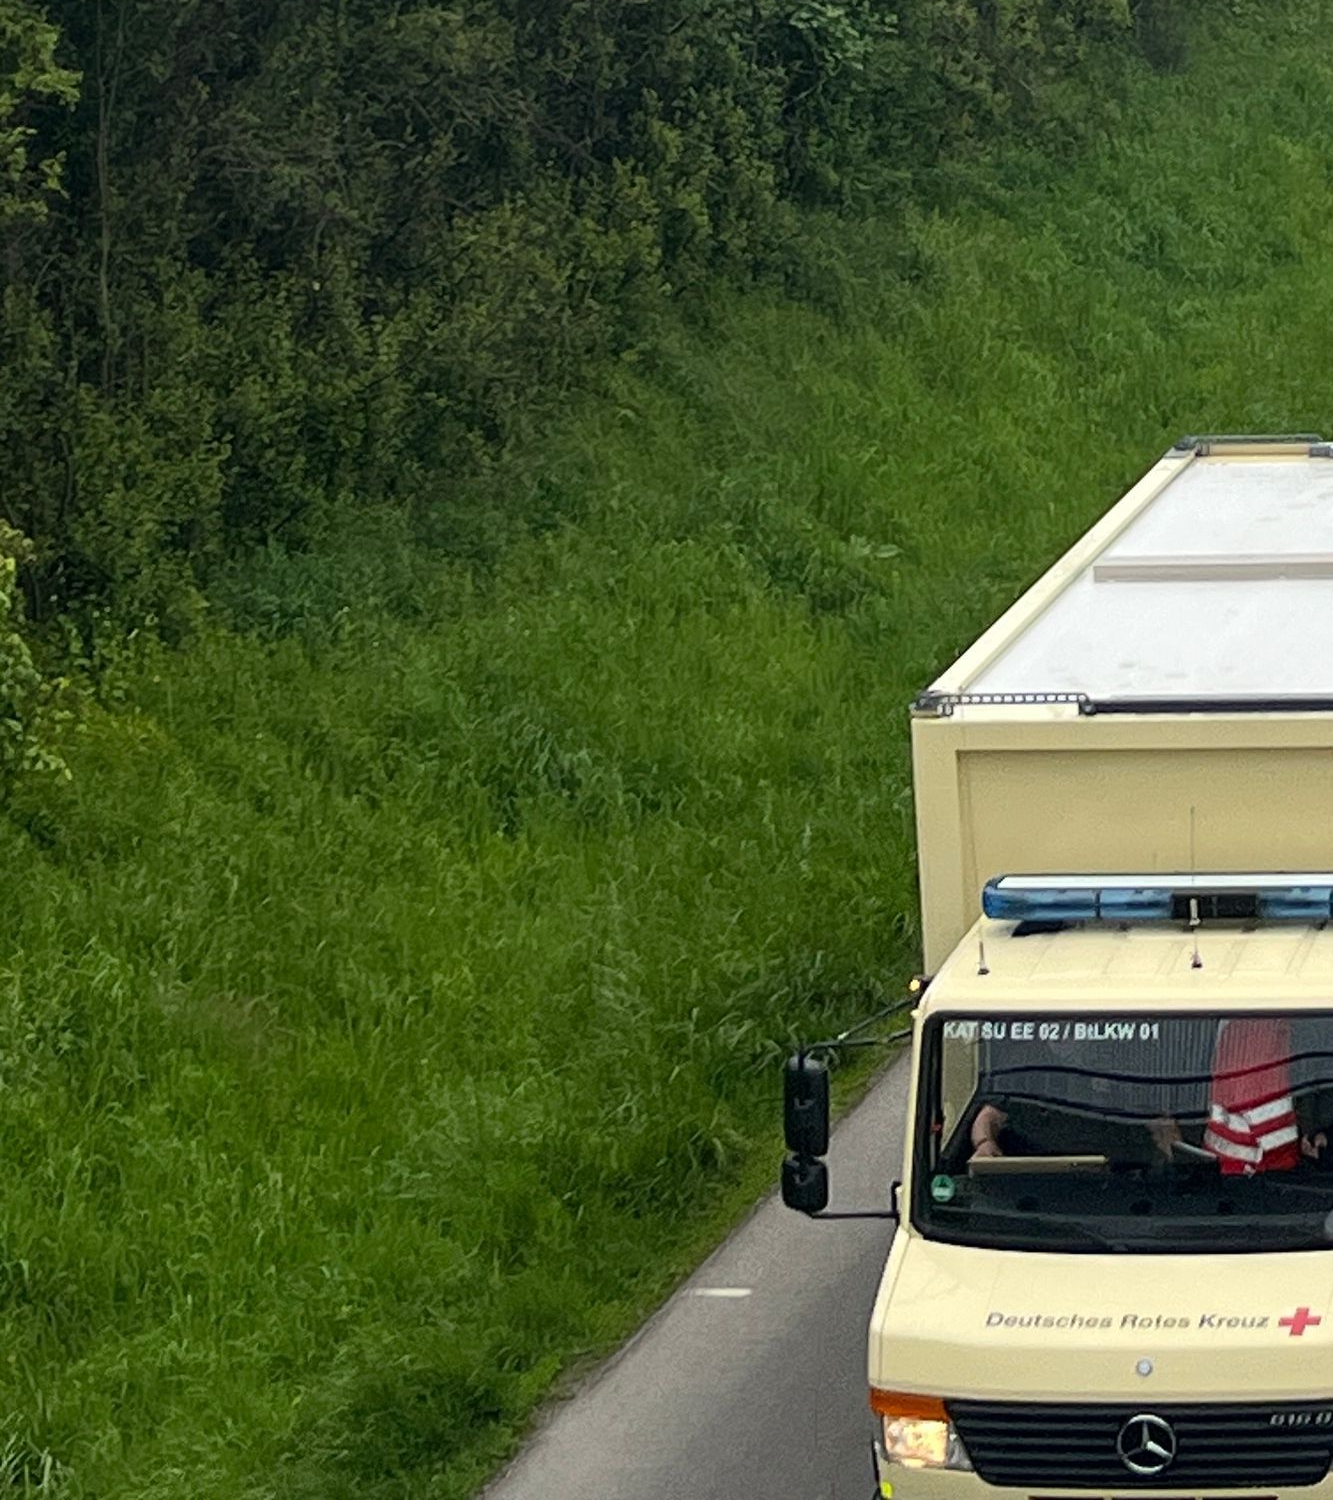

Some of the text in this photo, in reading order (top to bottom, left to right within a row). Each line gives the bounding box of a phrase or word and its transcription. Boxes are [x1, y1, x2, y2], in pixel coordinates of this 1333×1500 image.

[943, 1021, 979, 1041] KAT
[981, 1021, 1007, 1040] SU
[1010, 1022, 1035, 1040] EE
[1039, 1023, 1060, 1040] 02
[1063, 1023, 1071, 1040] /
[1139, 1023, 1160, 1040] 01
[985, 1311, 1270, 1329] Deutsches Rotes Kreuz
